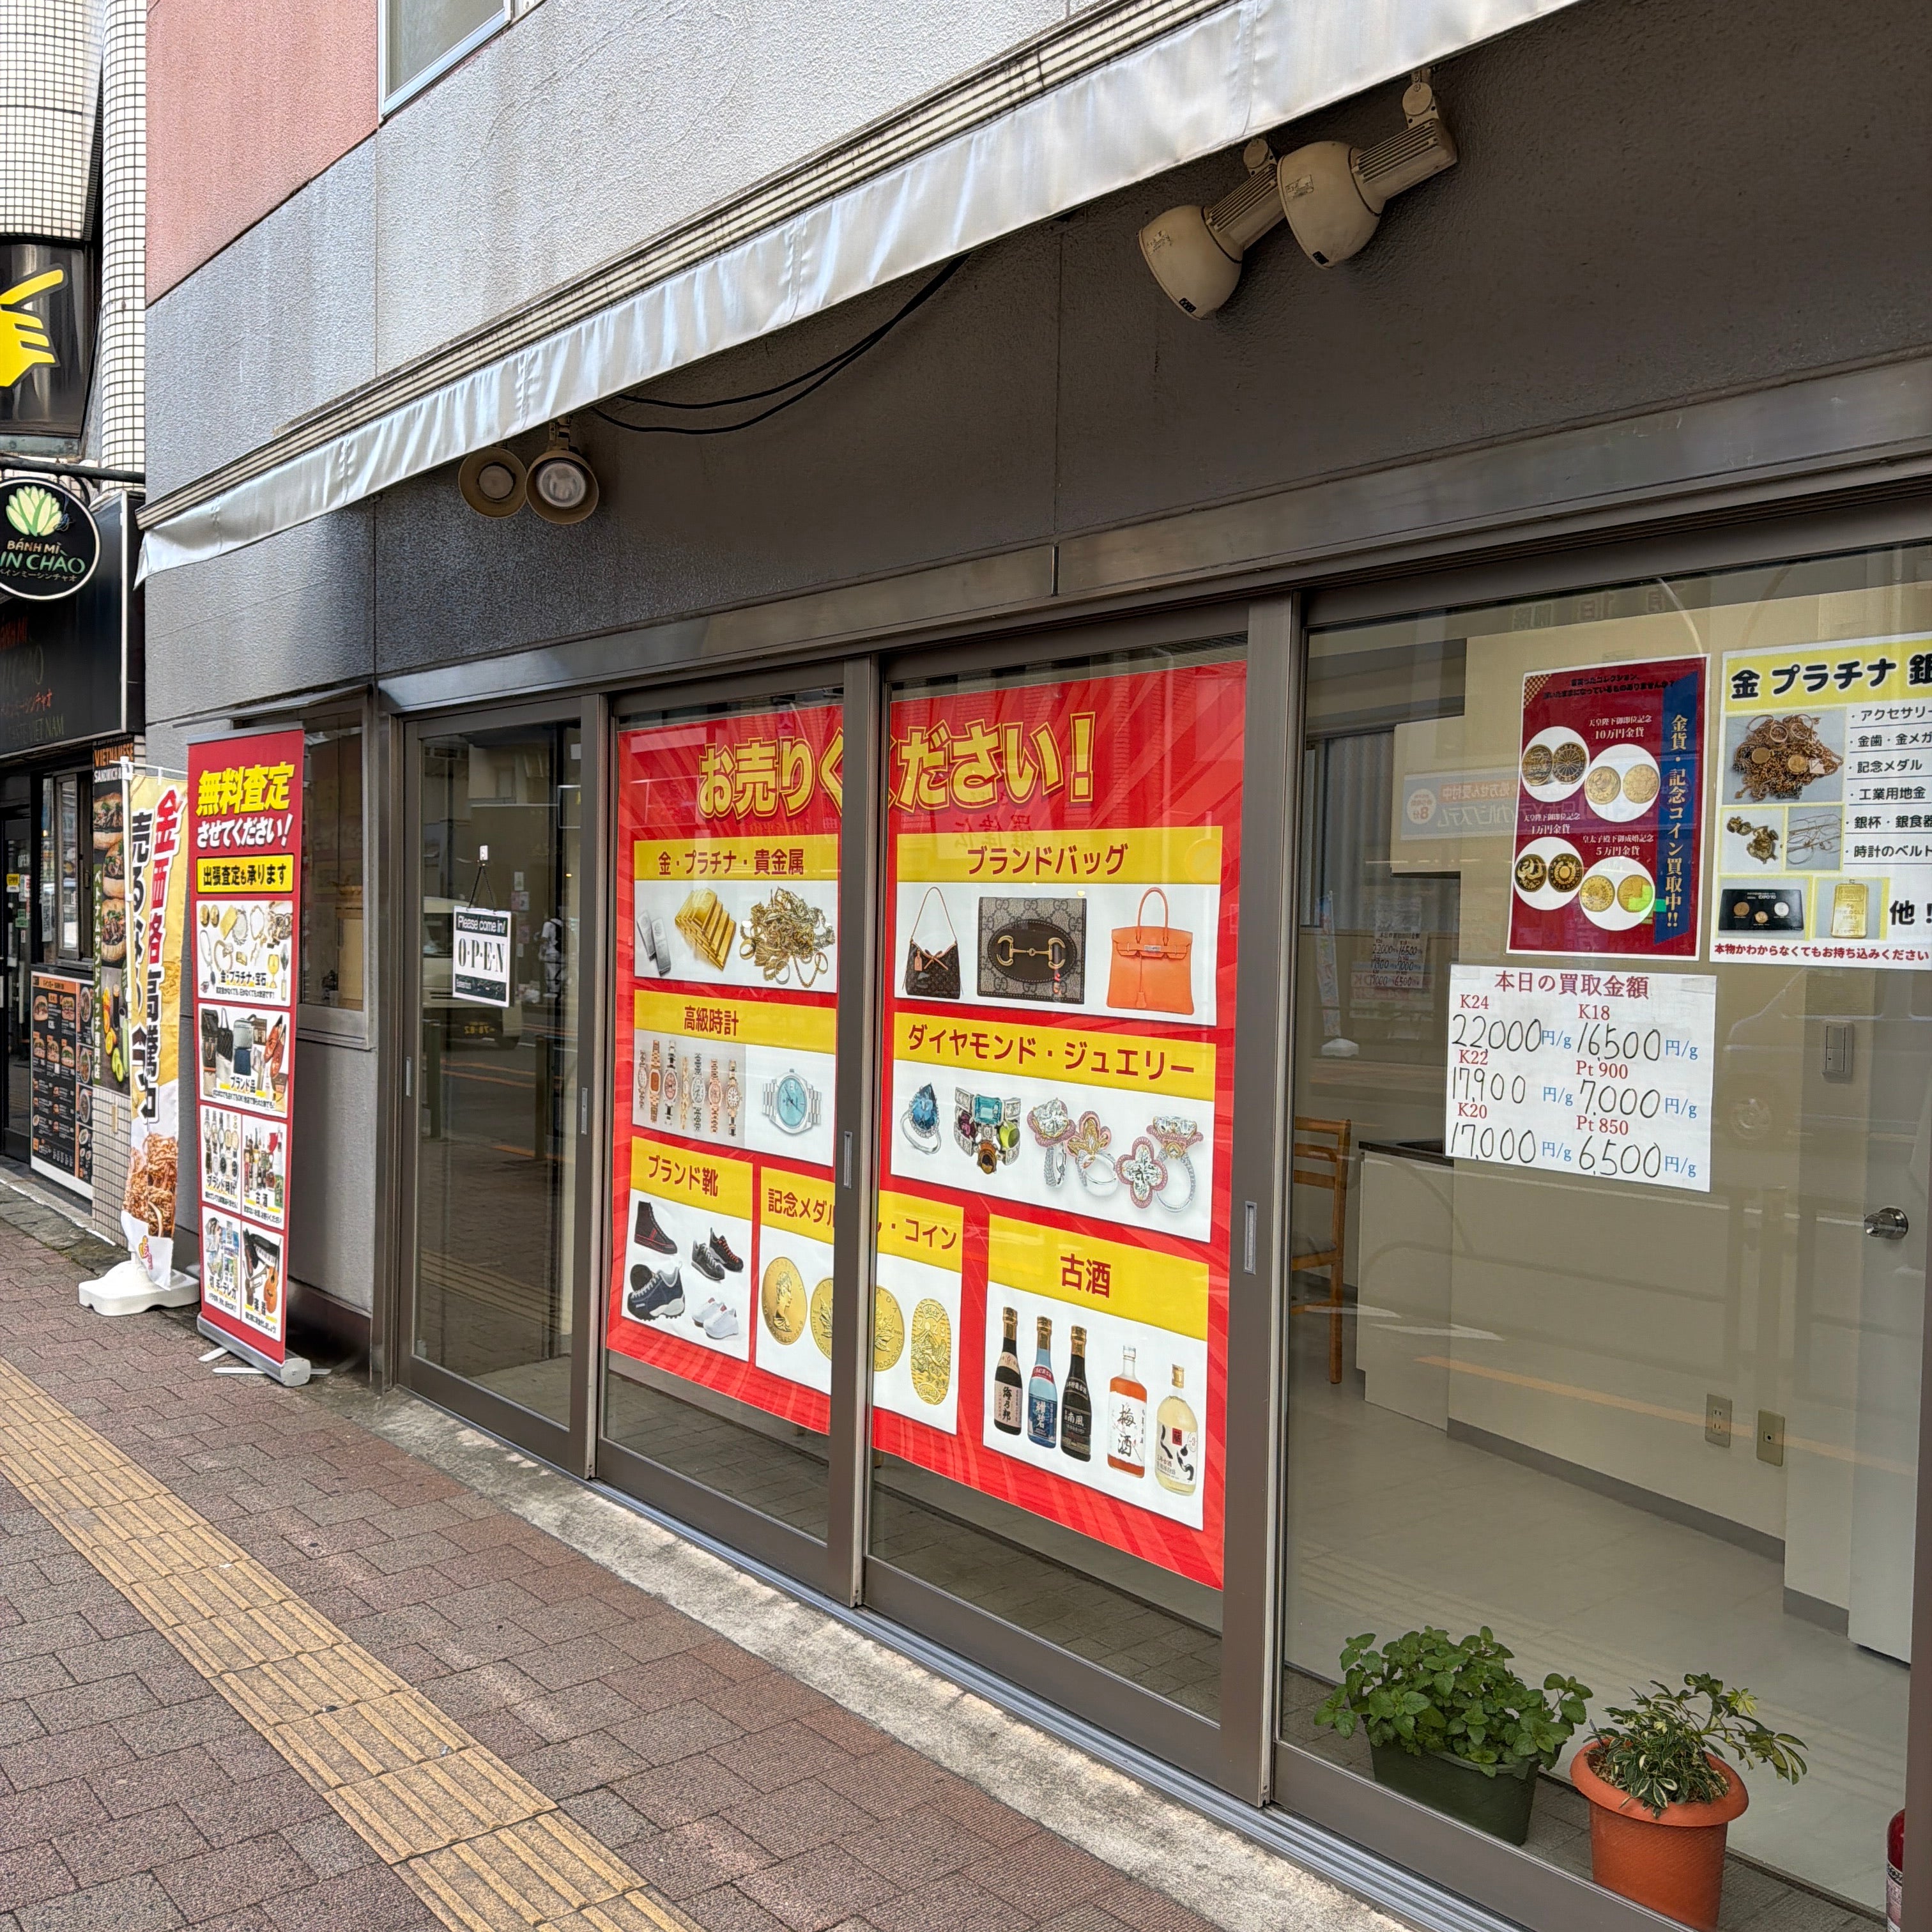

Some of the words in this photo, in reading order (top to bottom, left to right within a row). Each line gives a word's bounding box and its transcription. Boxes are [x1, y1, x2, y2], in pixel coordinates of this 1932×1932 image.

[7, 537, 42, 553] BÁNH
[26, 549, 86, 574] CHÀO
[1731, 670, 1760, 699] 金
[1772, 658, 1897, 695] プラチナ
[1595, 727, 1644, 740] 10万円金貨
[1857, 759, 1922, 774] 記念メダル
[195, 761, 295, 817] 無料査定
[1859, 786, 1926, 801] 工業用地金
[1531, 824, 1571, 835] 1万円金貨
[659, 848, 804, 875] 金・プラチナ・貴金属
[967, 843, 1129, 876] ブランドバッグ
[203, 863, 286, 886] 出張査定も承ります
[458, 916, 479, 930] Please
[479, 919, 496, 932] come
[1494, 970, 1650, 999] 本日の買取金額
[1460, 994, 1489, 1009] K24
[1578, 1004, 1610, 1020] K18
[684, 1006, 739, 1036] 高級時計
[908, 1024, 1195, 1080] ダイヤモンド・ジュエリー
[1459, 1050, 1489, 1065] K22
[1575, 1061, 1594, 1077] Pt
[1598, 1062, 1629, 1079] 900
[1457, 1103, 1487, 1119] K20
[1576, 1116, 1594, 1131] Pt
[1598, 1117, 1629, 1135] 850
[648, 1154, 719, 1197] ブランド靴
[1060, 1253, 1112, 1299] 古酒
[1117, 1404, 1136, 1457] 梅酒
